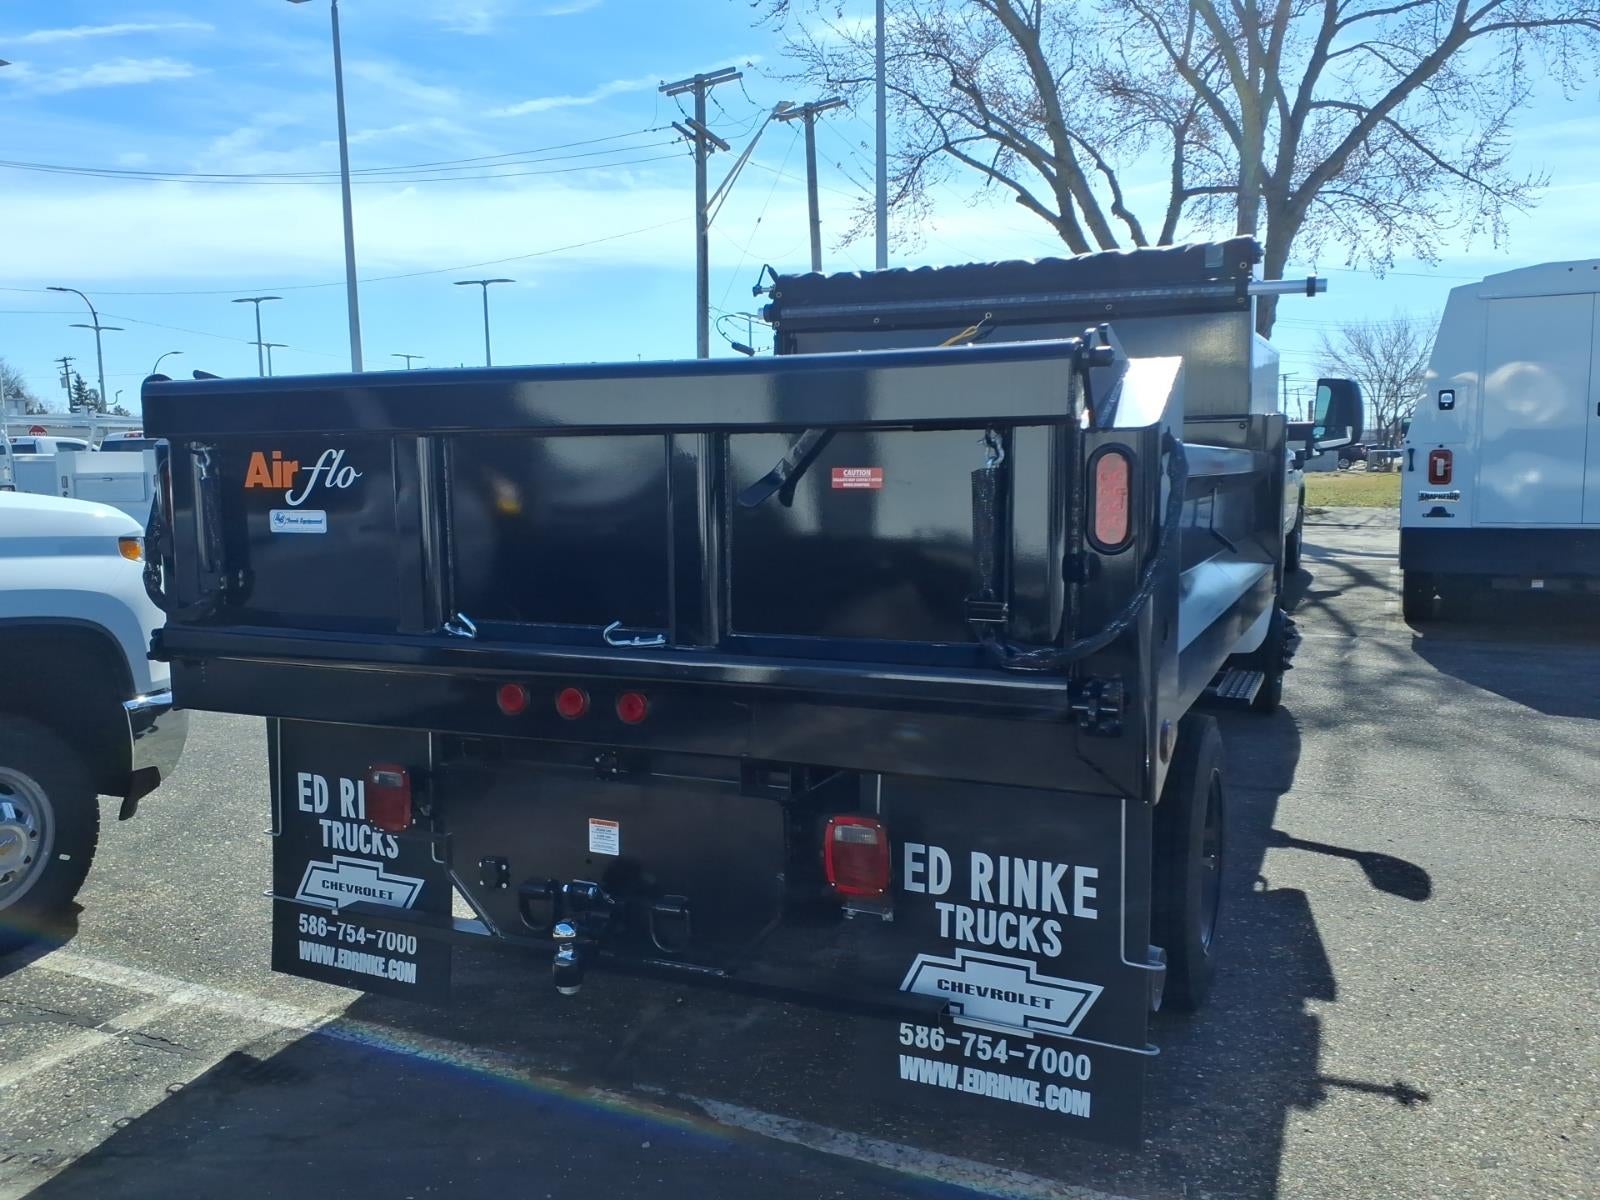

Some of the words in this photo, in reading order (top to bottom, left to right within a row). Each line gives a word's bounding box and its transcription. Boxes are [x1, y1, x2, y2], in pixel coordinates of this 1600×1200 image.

[244, 450, 299, 488] Air
[297, 772, 329, 814] ED
[319, 818, 399, 859] TRUCKS
[321, 879, 395, 901] CHEVROLET
[903, 841, 952, 895] ED
[970, 851, 1099, 920] RINKE
[298, 913, 417, 955] 586-754-7000
[935, 901, 1062, 958] TRUCKS
[298, 940, 417, 984] WWW.EDRINKE.COM
[936, 978, 1056, 1010] CHEVROLET
[899, 1022, 1092, 1081] 586-754-7000
[899, 1054, 1091, 1118] WWW.EDRINKE.COM
